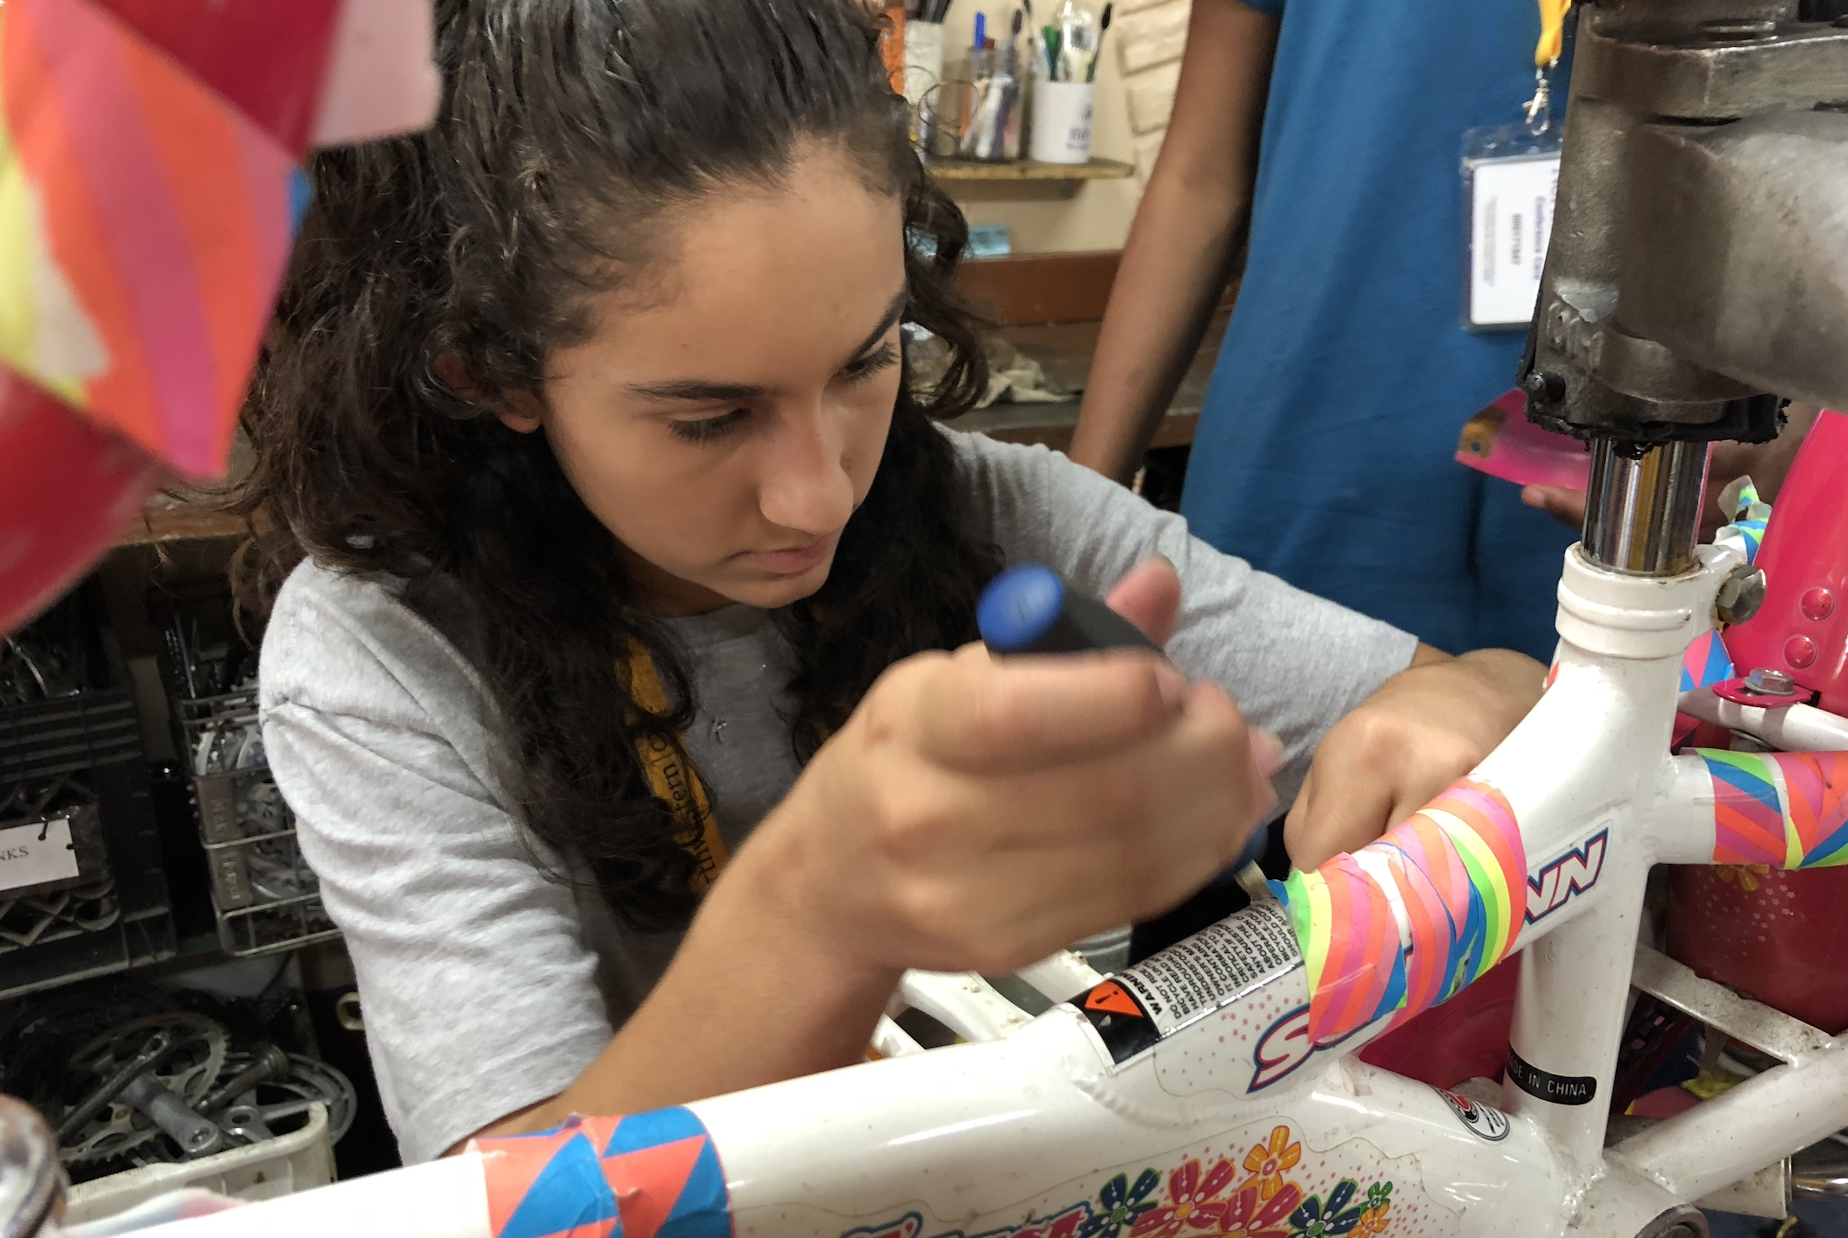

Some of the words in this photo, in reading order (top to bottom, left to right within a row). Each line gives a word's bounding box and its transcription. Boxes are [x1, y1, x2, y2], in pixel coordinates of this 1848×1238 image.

[1252, 906, 1271, 921] CON
[1208, 935, 1219, 944] TO
[1215, 921, 1252, 954] QUESTION
[1236, 924, 1252, 938] THE
[1243, 920, 1282, 965] OPERATION
[1271, 922, 1298, 957] SHOULD
[1177, 944, 1194, 955] MAN
[1250, 940, 1274, 968] ABOUT
[1160, 962, 1181, 983] READ
[1191, 943, 1227, 981] CONTAINS
[1221, 944, 1249, 982] CRITICAL
[1250, 957, 1265, 973] ANY
[1139, 968, 1157, 983] RIDE
[1193, 956, 1224, 995] OWNER'S
[1119, 969, 1161, 1015] WARNIN
[1155, 985, 1172, 1003] NOT
[1161, 976, 1190, 1014] BICYCLE
[1180, 984, 1198, 1009] HAVE
[1224, 984, 1233, 992] IT
[1170, 1004, 1182, 1019] DO
[1528, 1072, 1541, 1088] IN
[1547, 1079, 1587, 1096] CHINA
